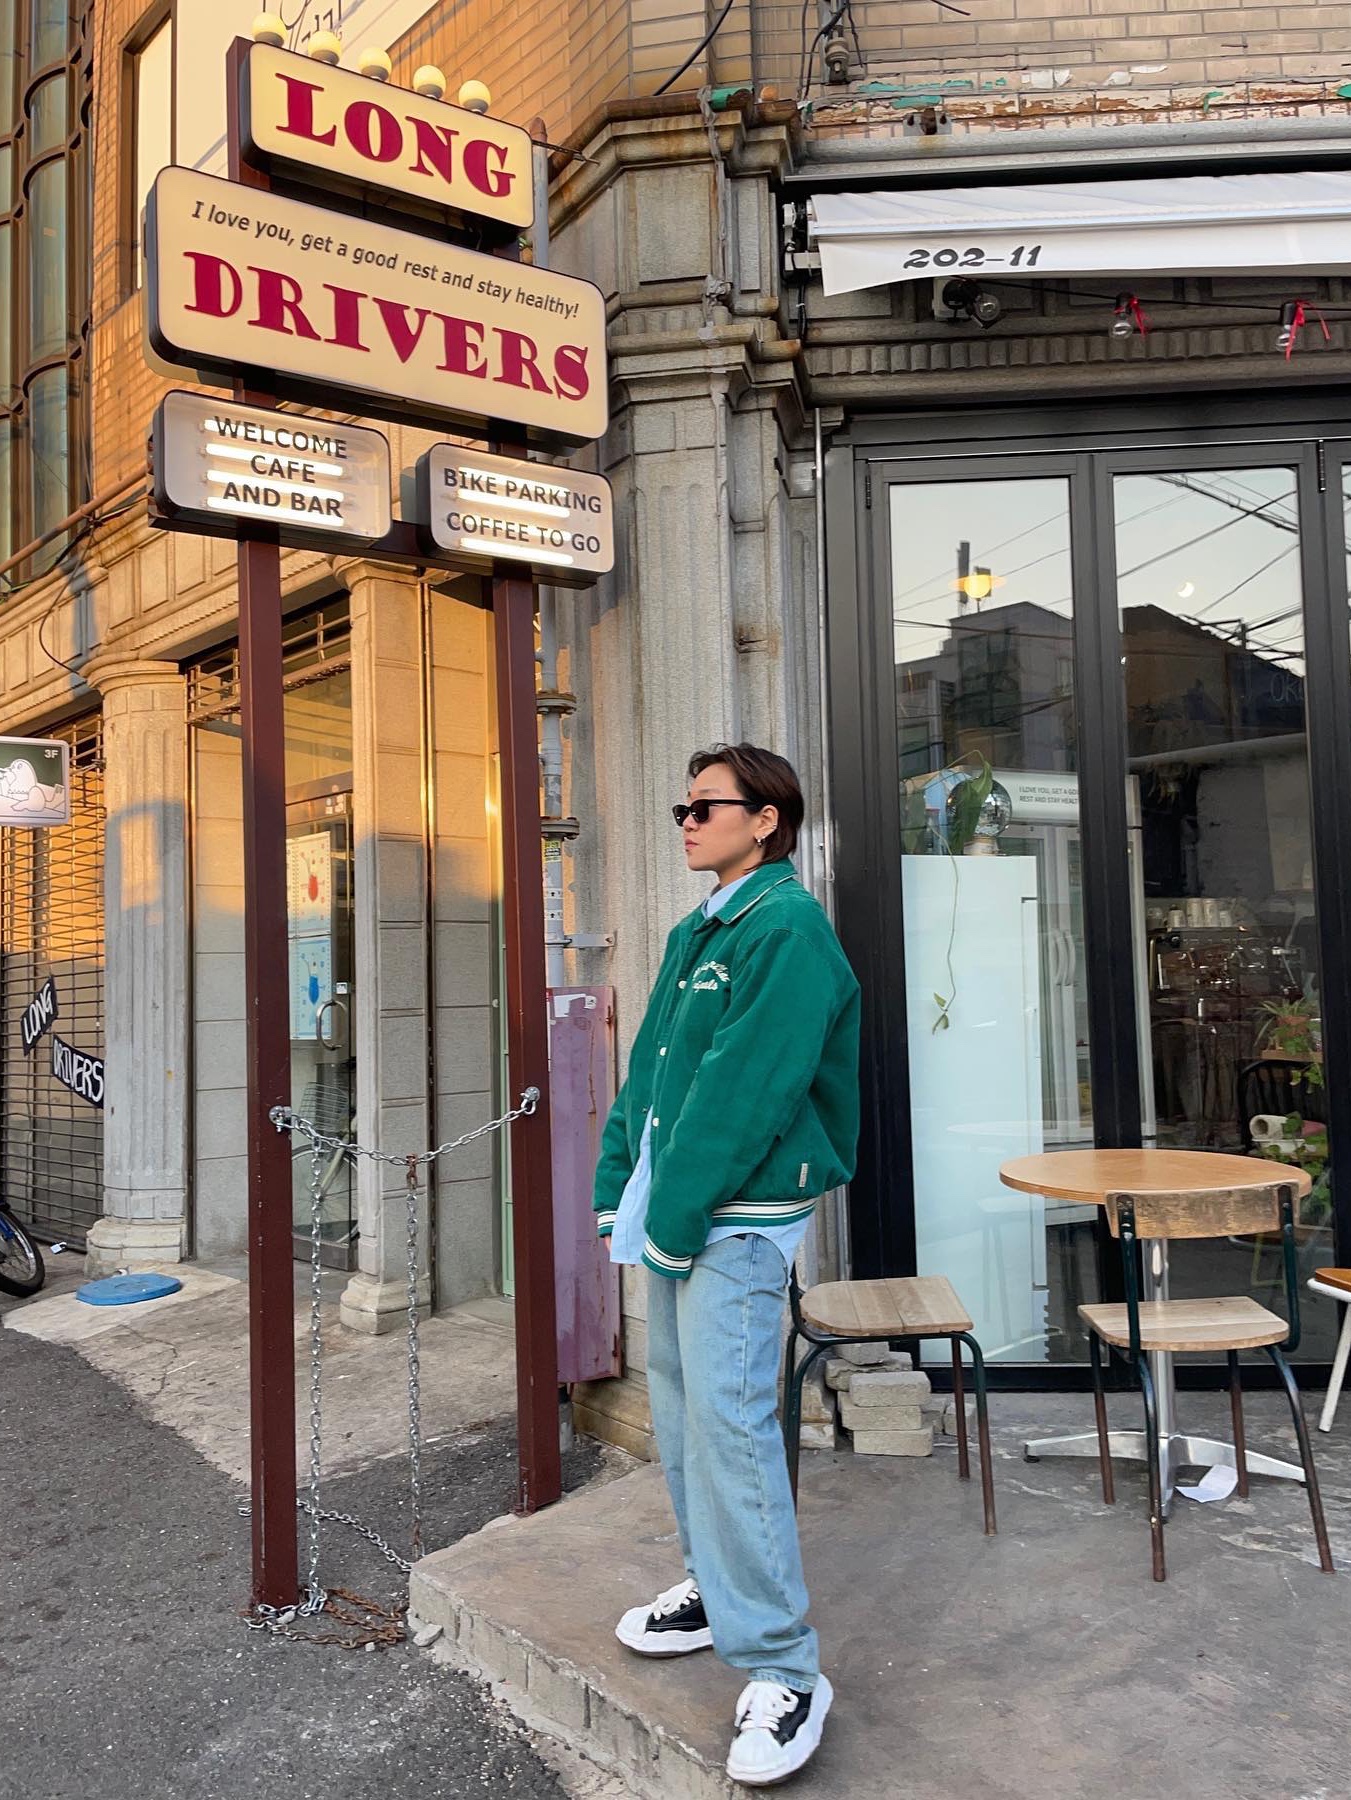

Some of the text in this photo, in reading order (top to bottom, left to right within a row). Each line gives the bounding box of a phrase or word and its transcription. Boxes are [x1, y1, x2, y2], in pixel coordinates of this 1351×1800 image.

[275, 73, 516, 198] LONG
[192, 201, 579, 319] I love you, get a good rest and stay healthy!
[903, 245, 1042, 269] 202-11
[183, 251, 590, 400] DRIVERS
[214, 416, 348, 459] WELCOME
[250, 455, 315, 483] CAFE
[444, 468, 602, 513] BIKE PARKING
[223, 482, 343, 518] AND BAR
[447, 512, 600, 553] COFFEE TO GO
[44, 749, 59, 759] 3F
[23, 983, 53, 1044] LONG
[54, 1039, 104, 1102] DRIVERS
